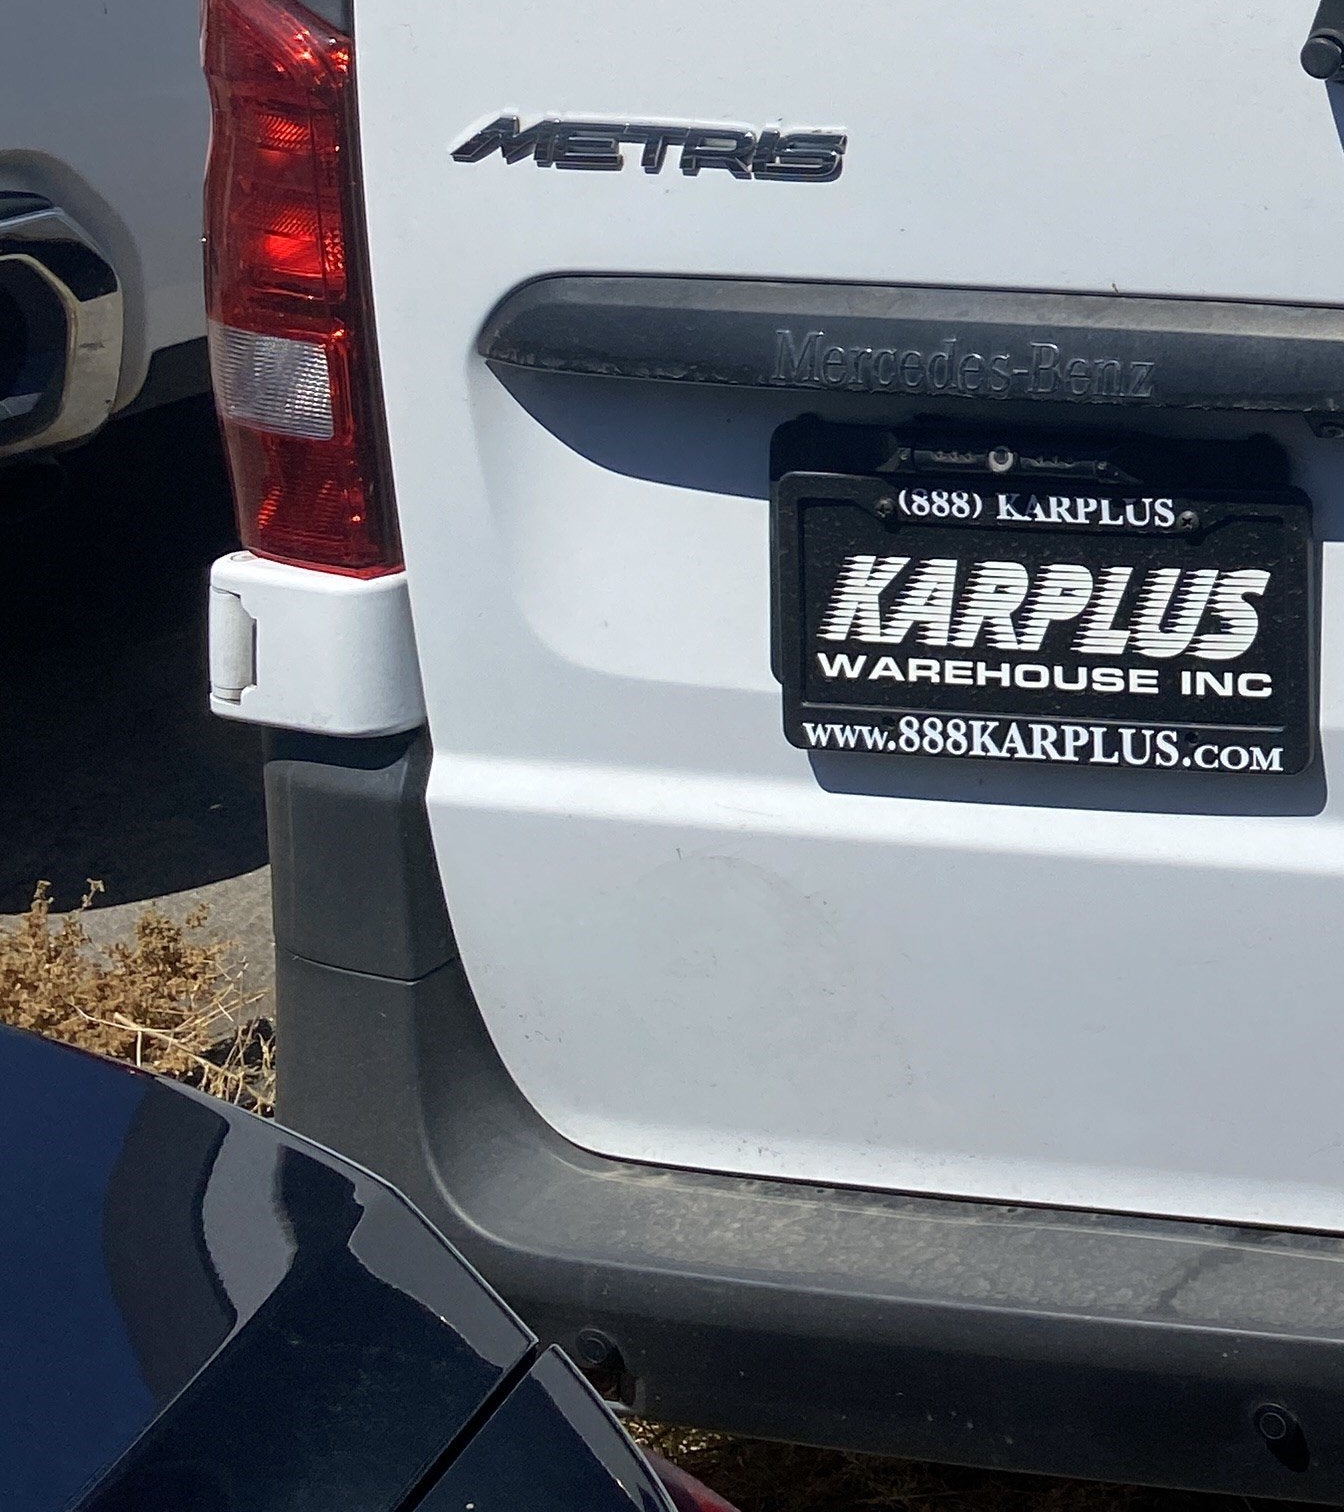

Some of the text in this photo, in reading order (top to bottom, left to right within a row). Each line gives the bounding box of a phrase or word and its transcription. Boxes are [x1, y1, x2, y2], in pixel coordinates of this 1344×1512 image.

[450, 115, 848, 182] METRIS
[770, 329, 1155, 398] Mercedes-Benz
[898, 488, 1176, 527] (888) KARPLUS
[816, 555, 1271, 660] KARPLUS
[817, 652, 1273, 698] WAREHOUSE INC
